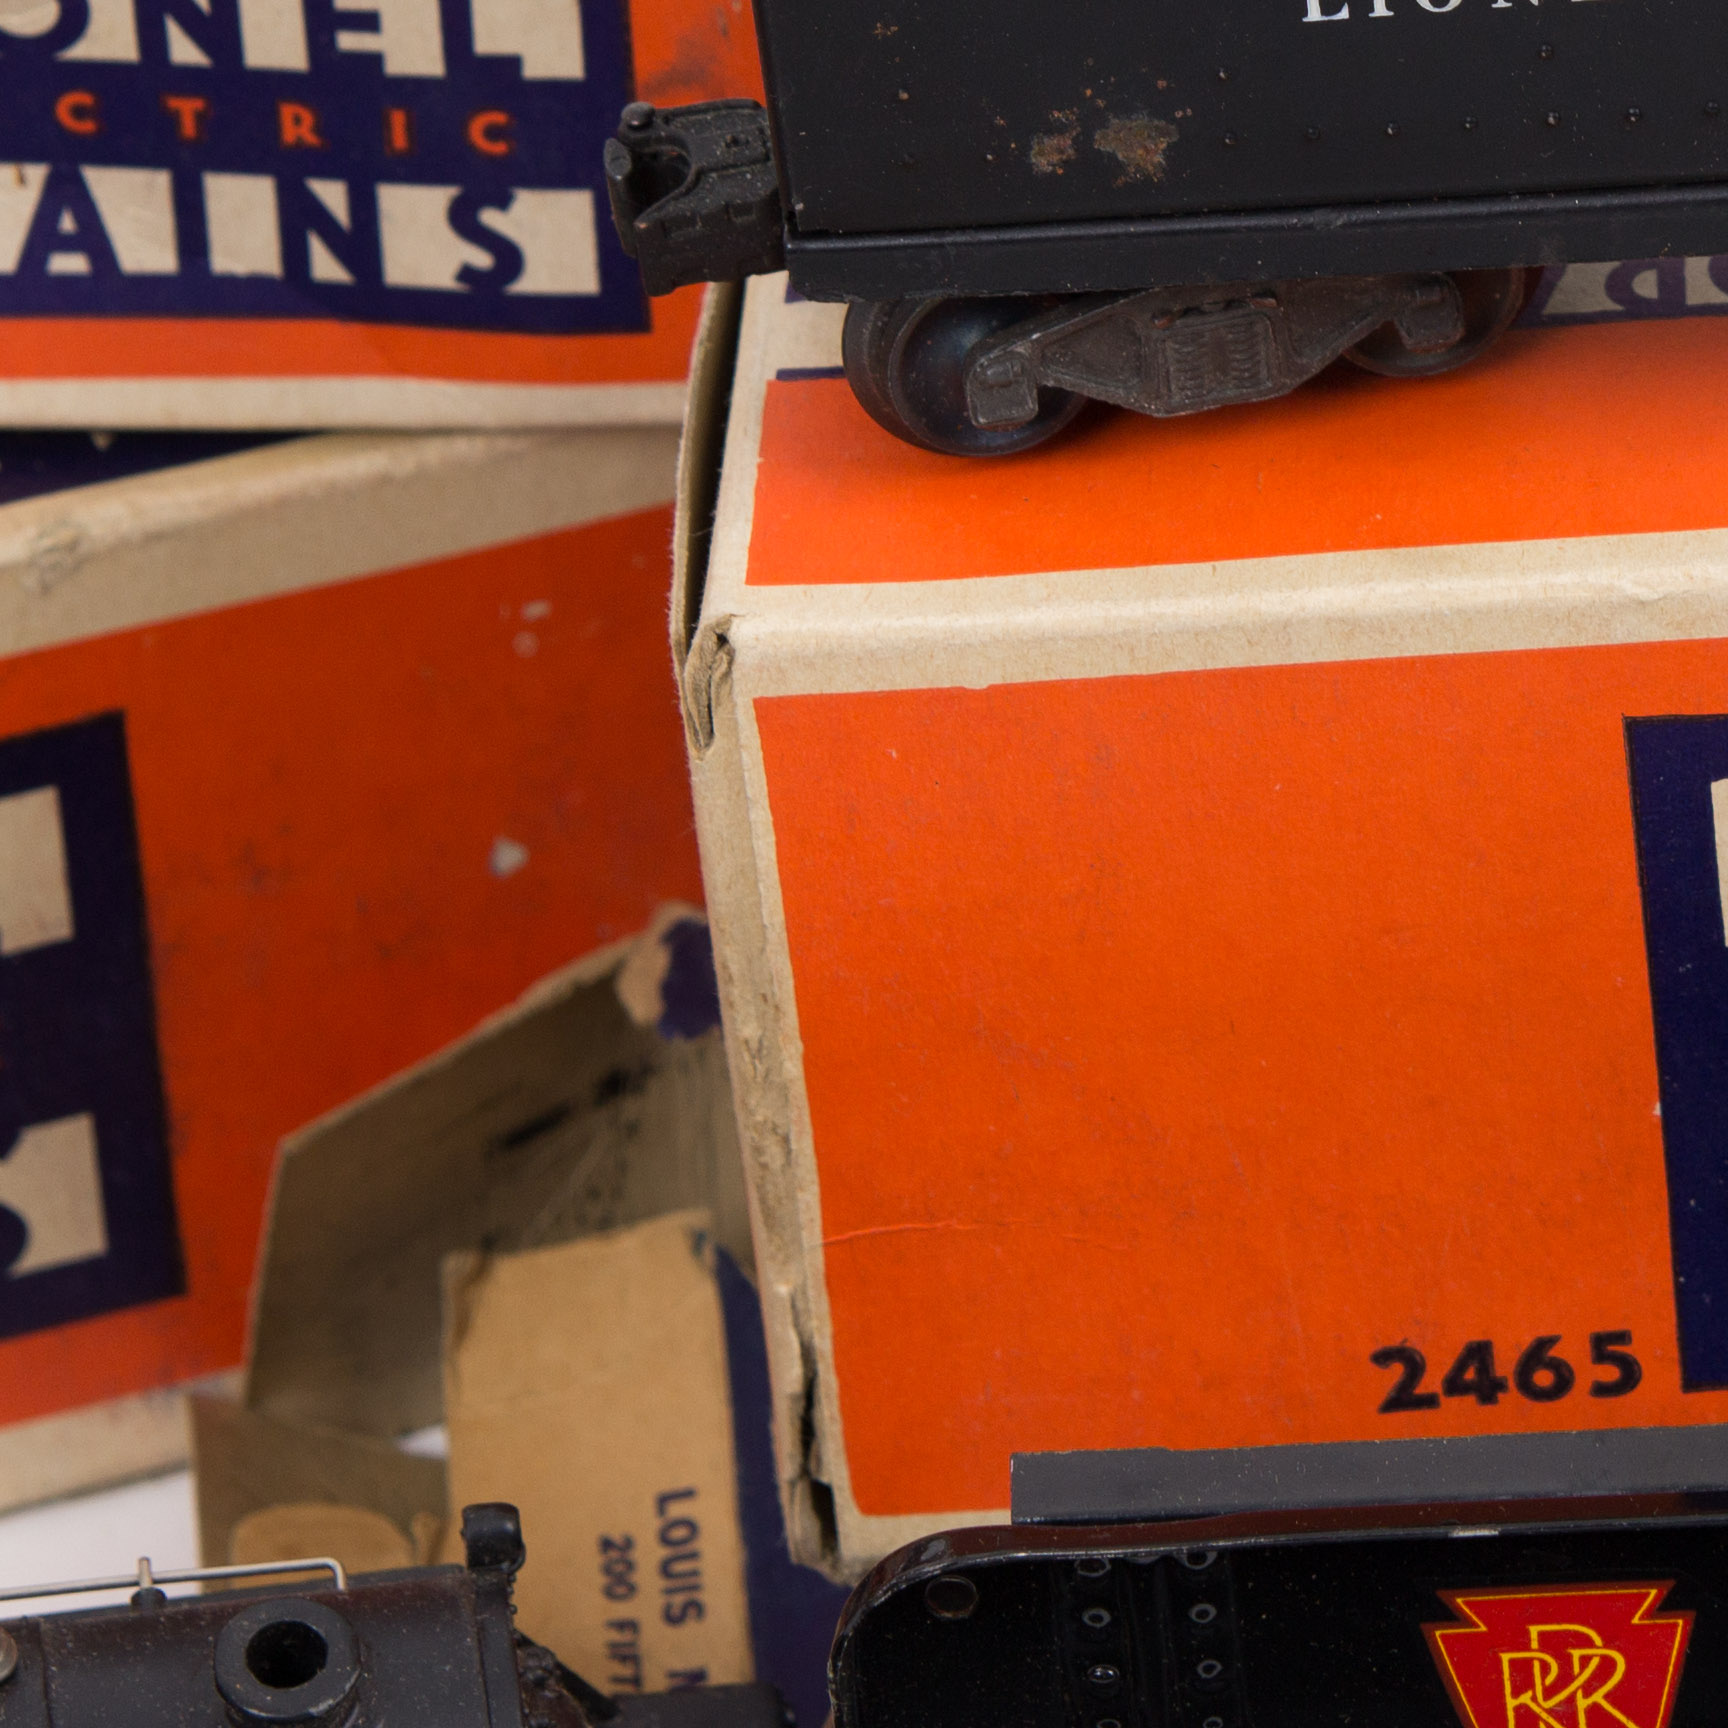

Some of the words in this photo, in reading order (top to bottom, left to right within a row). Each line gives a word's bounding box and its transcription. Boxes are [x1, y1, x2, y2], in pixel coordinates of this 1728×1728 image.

[1370, 1330, 1643, 1414] 2465
[599, 1535, 637, 1602] 200
[657, 1486, 705, 1627] LOUIS
